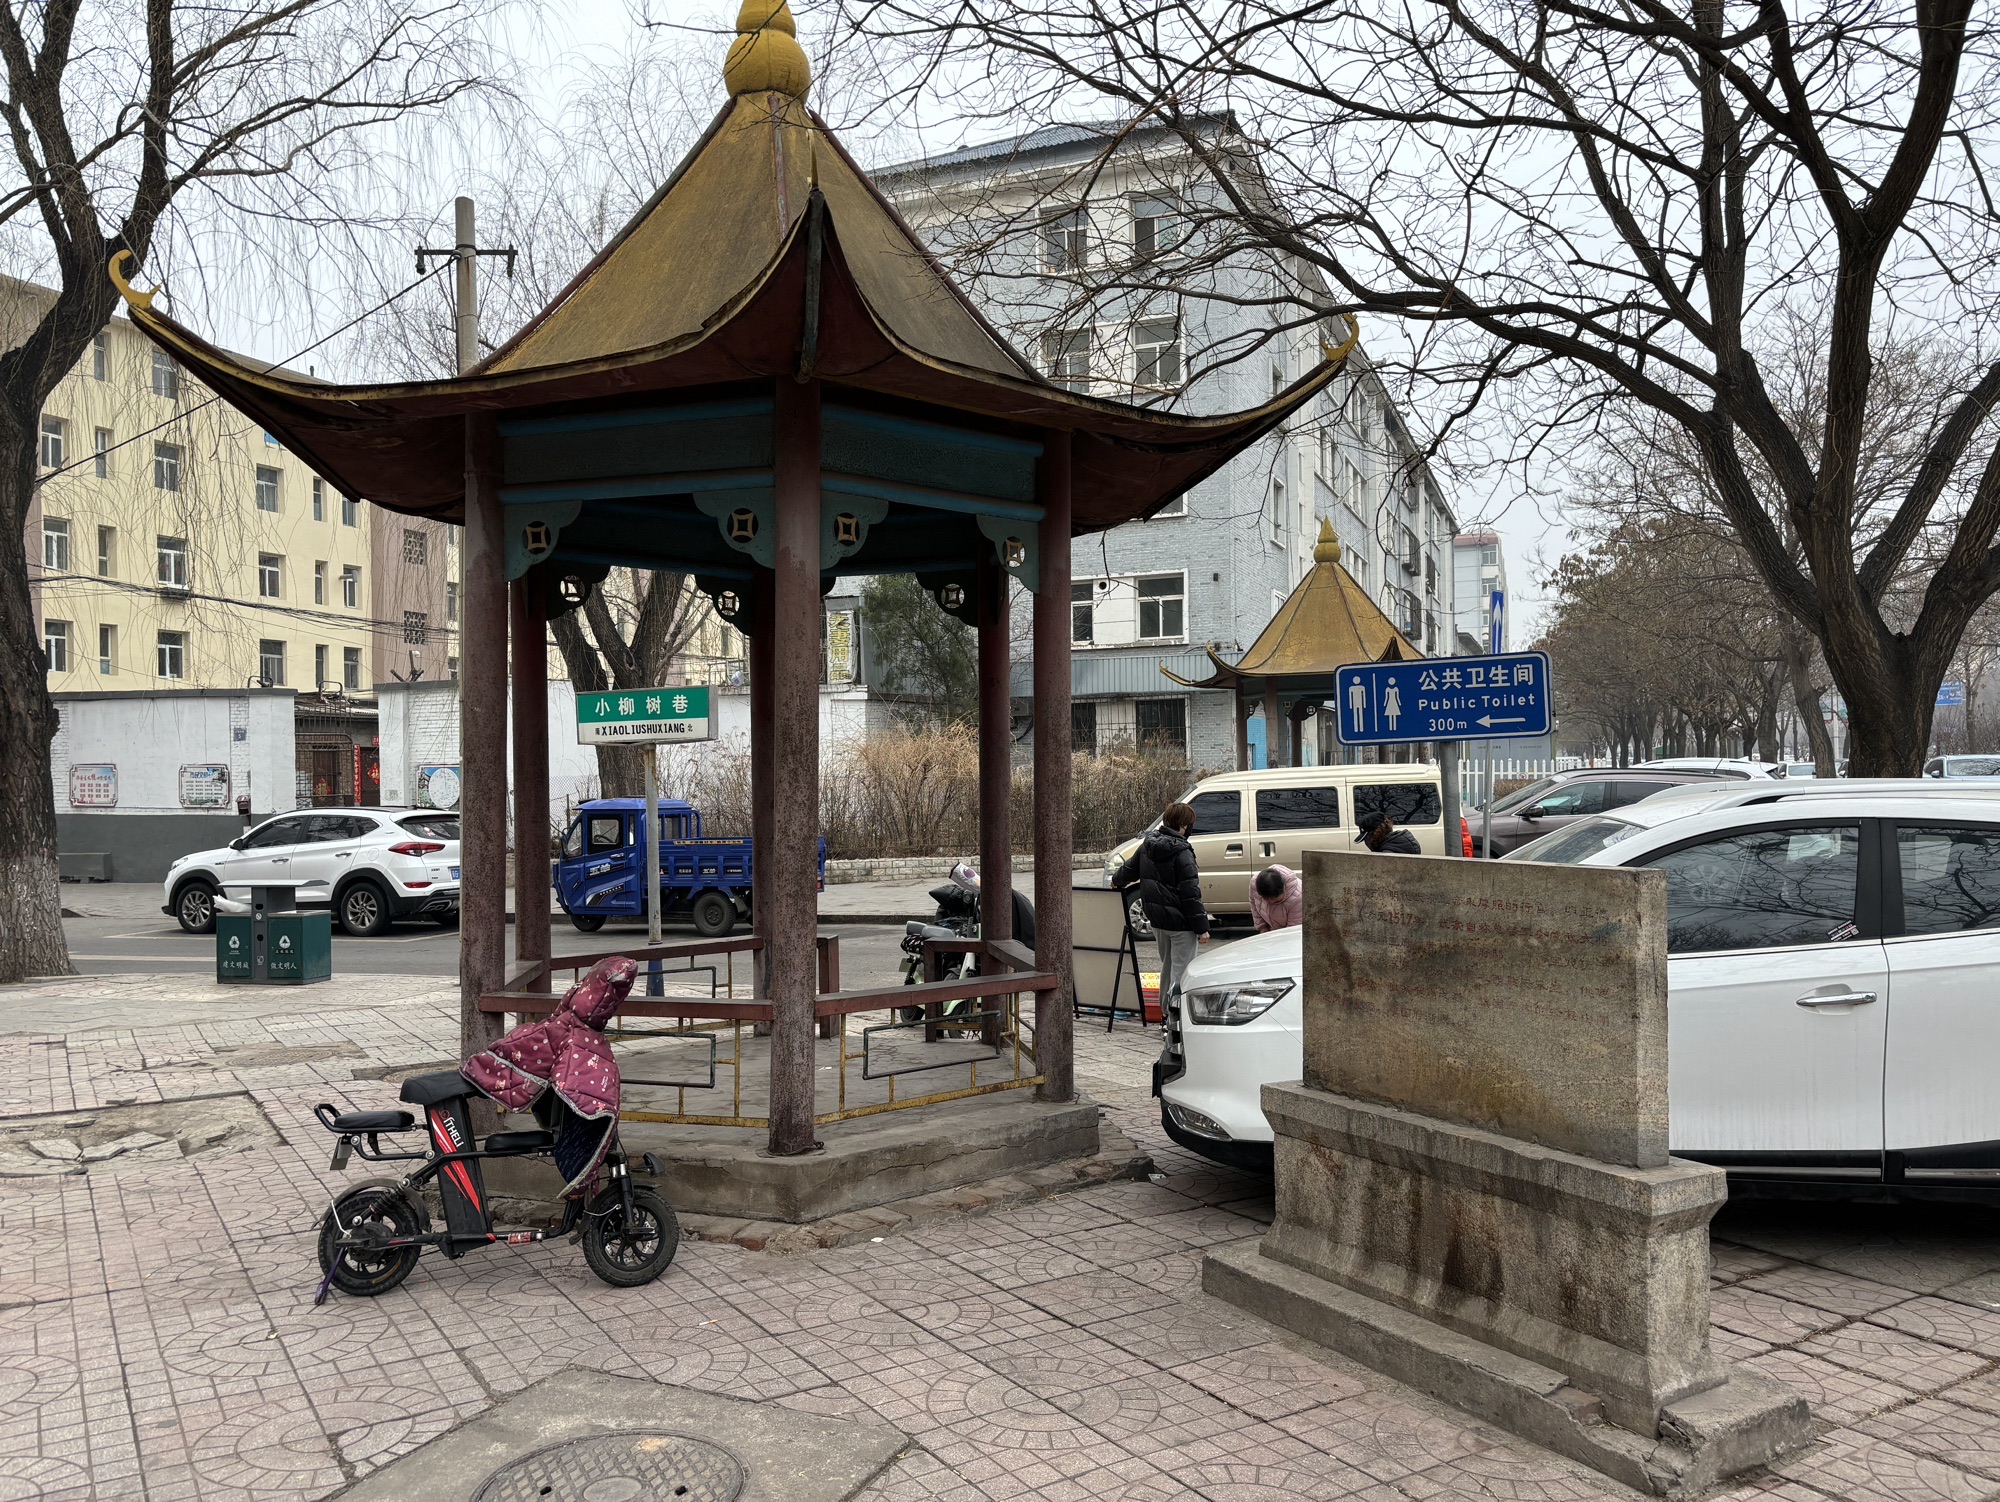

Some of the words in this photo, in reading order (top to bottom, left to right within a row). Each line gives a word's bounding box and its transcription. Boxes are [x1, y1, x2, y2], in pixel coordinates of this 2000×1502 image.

[829, 612, 853, 681] 夫妻用品
[1418, 663, 1534, 691] 公共卫生间
[595, 694, 688, 717] 小柳树巷
[1418, 697, 1476, 711] Public
[1481, 693, 1536, 709] Toilet
[601, 723, 685, 736] XIAOLIUSHUXIANG
[1428, 718, 1468, 732] 300m
[270, 961, 297, 970] 做文明人
